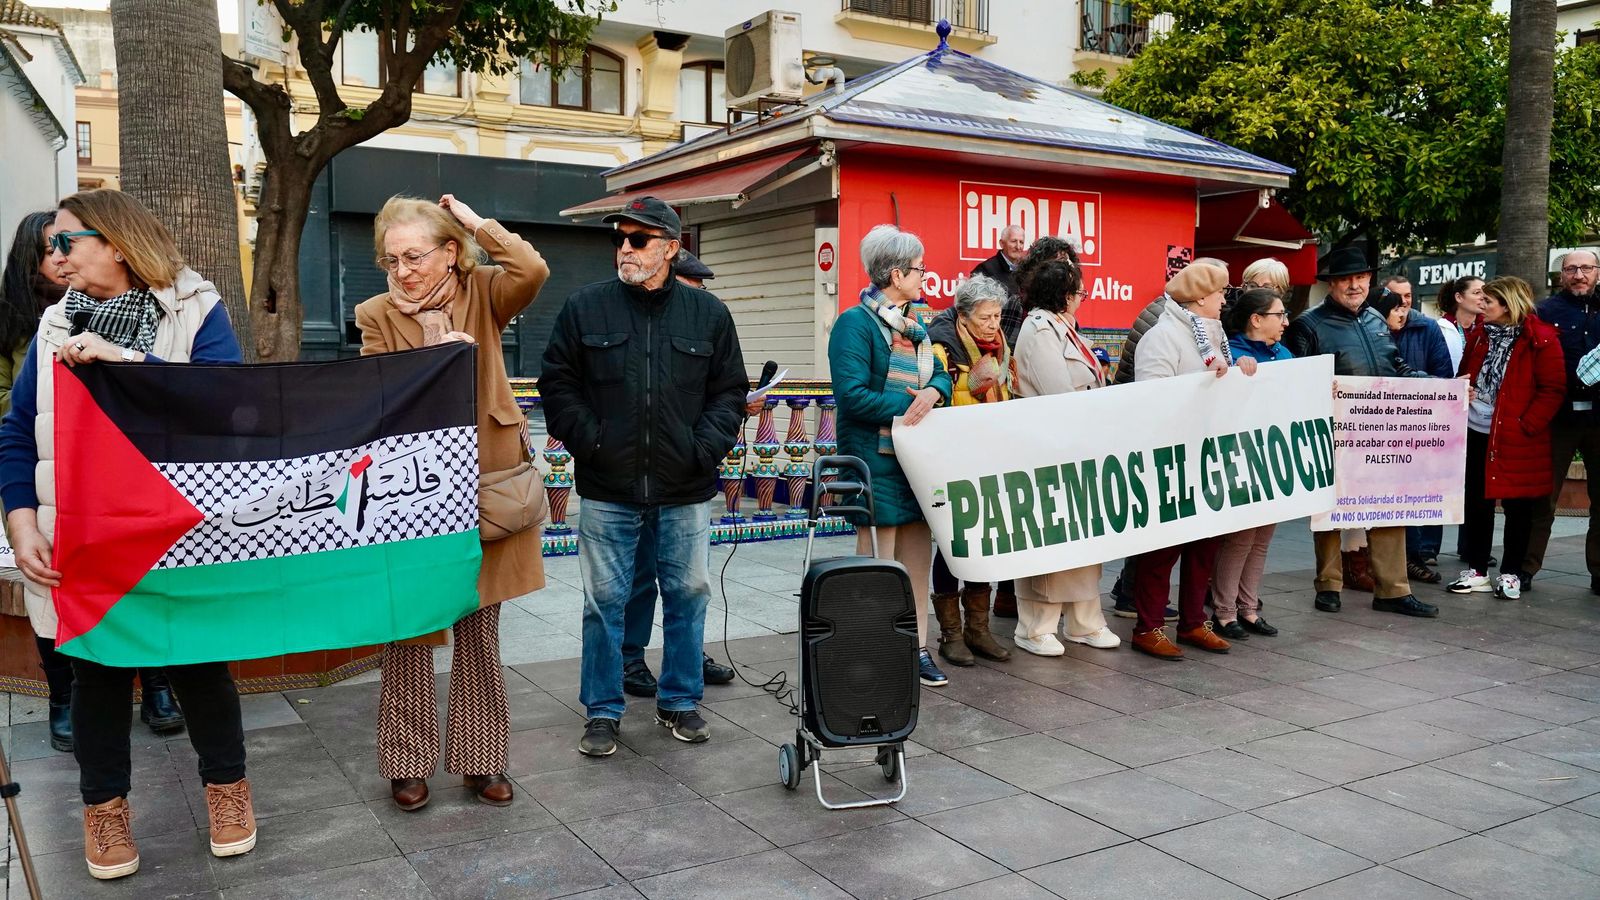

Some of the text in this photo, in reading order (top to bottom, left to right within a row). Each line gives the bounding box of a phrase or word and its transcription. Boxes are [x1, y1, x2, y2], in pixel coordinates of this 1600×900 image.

[966, 190, 1095, 256] ¡HOLA!
[1418, 260, 1486, 286] FEMME
[1091, 277, 1133, 300] Alta
[1337, 390, 1381, 400] Comunidad
[1383, 391, 1437, 401] Internacional
[1447, 392, 1458, 401] ha
[1349, 405, 1433, 415] olvidado de Palestina
[1333, 422, 1450, 432] SRAEL tienen las manos libres
[1334, 438, 1445, 450] para acabar con el pueblo
[1365, 454, 1412, 464] PALESTINO
[946, 416, 1335, 558] PAREMOS EL GENOCID
[1358, 494, 1394, 505] Solidaridad
[1396, 496, 1403, 504] es
[1404, 493, 1443, 506] Importante
[1330, 509, 1443, 522] NO NOS OLVIDEMOS DE PALESTINA
